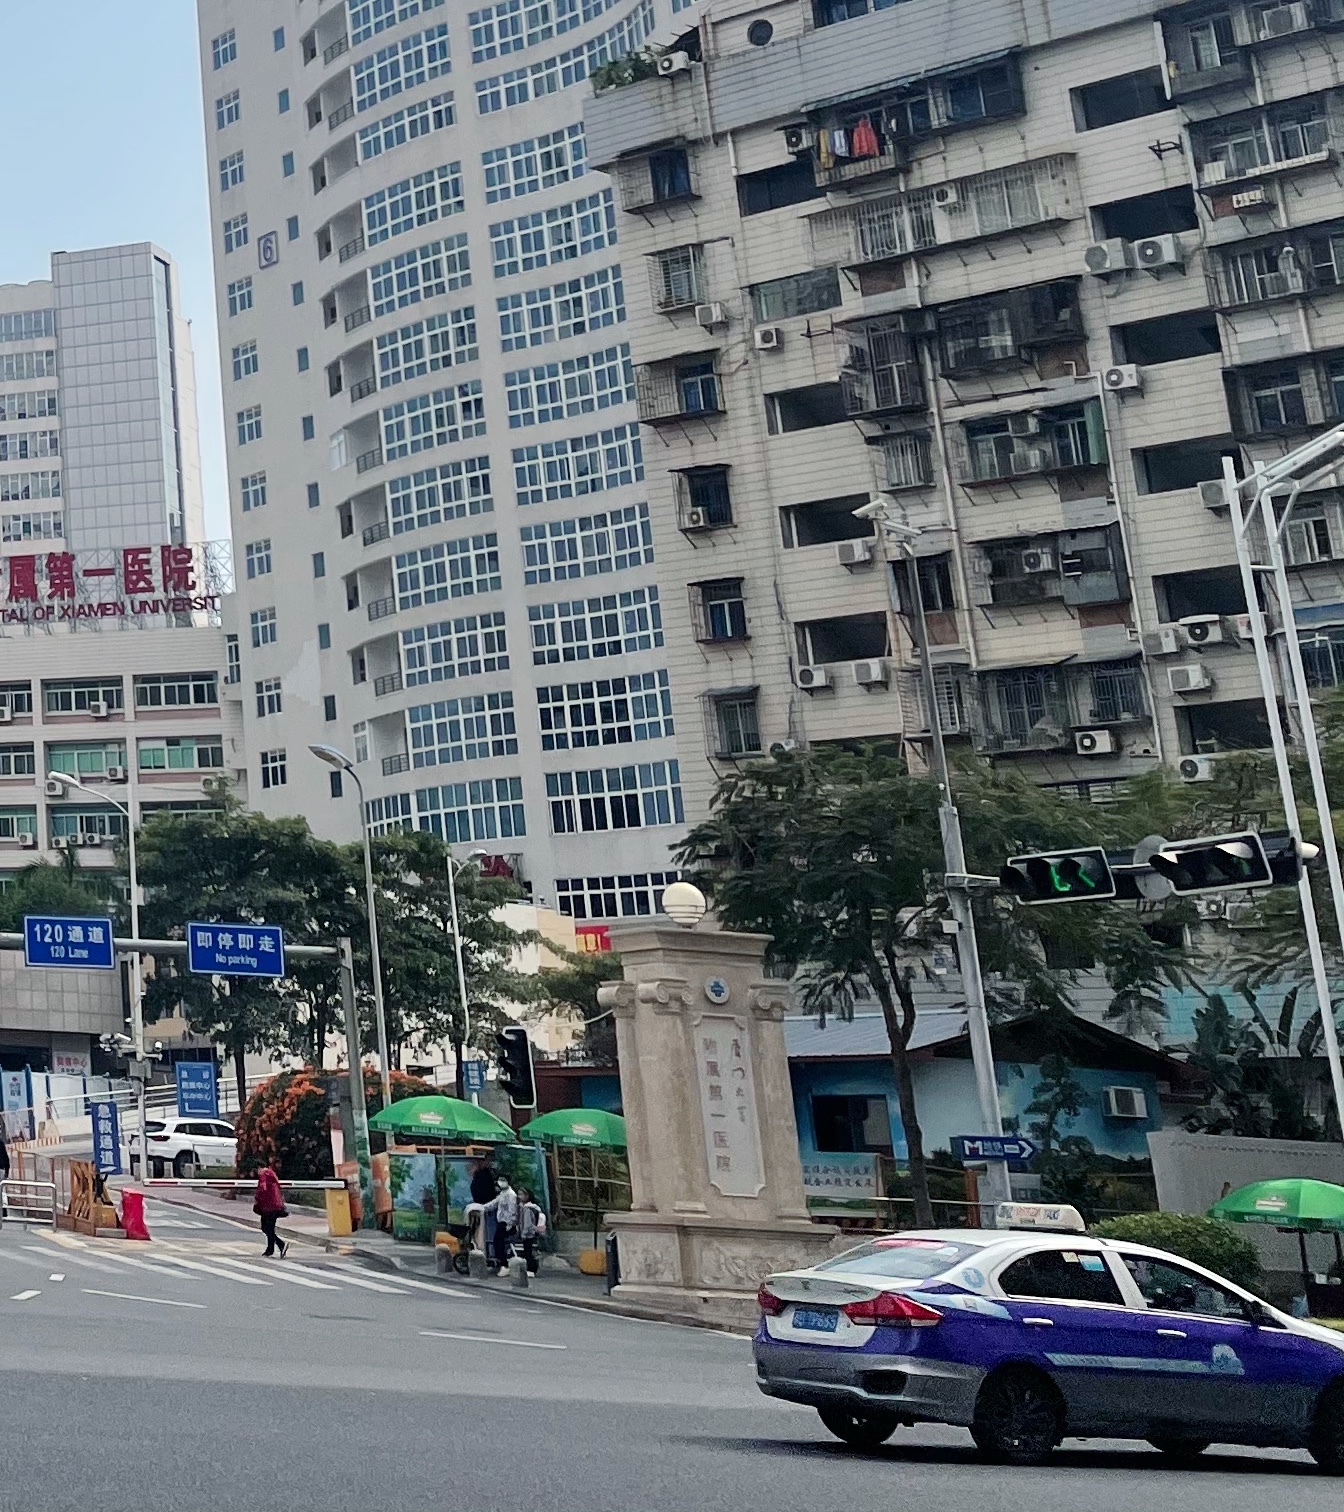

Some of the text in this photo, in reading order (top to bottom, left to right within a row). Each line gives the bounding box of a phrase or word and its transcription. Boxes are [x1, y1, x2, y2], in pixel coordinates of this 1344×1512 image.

[33, 606, 55, 620] OF
[61, 601, 125, 619] XIAMEN
[196, 930, 276, 953] 即停即走
[50, 945, 89, 959] 120 Lane
[215, 952, 258, 968] No parking
[97, 1103, 115, 1166] 急救通道
